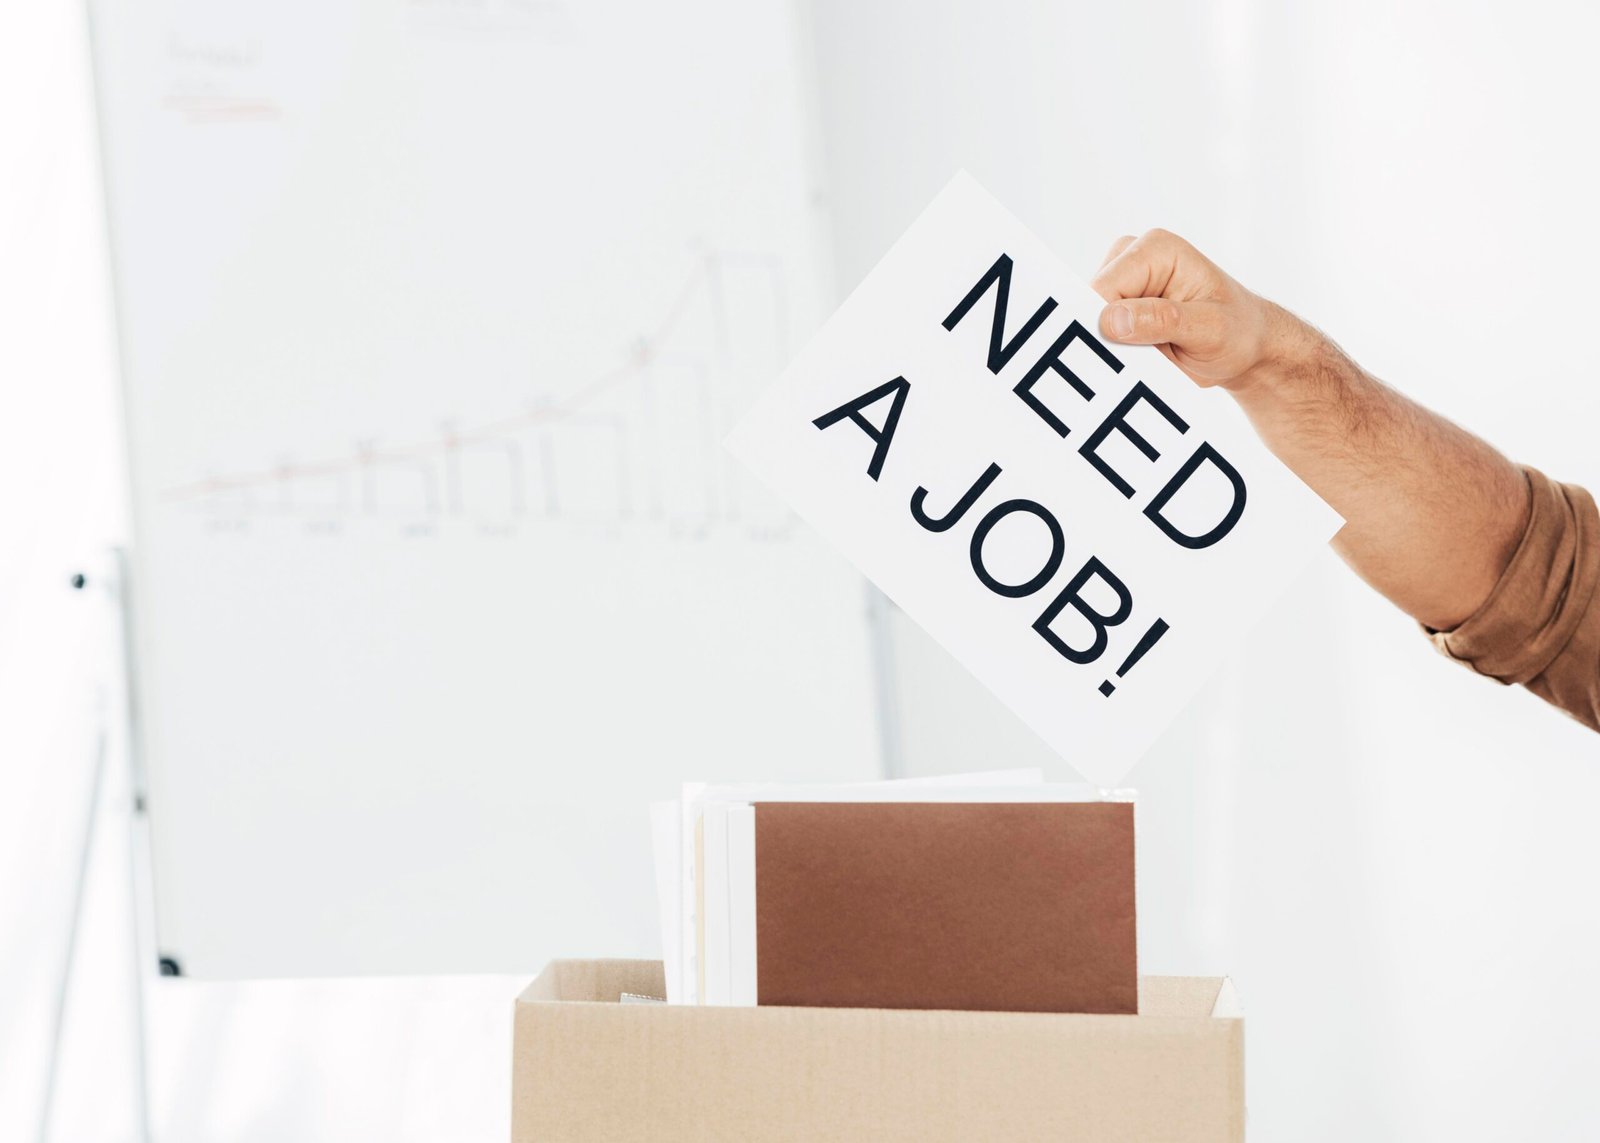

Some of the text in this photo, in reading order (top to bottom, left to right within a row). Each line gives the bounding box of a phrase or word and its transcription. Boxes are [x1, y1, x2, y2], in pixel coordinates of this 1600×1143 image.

[811, 375, 1170, 698] A JOB!
[941, 252, 1248, 550] NEED
